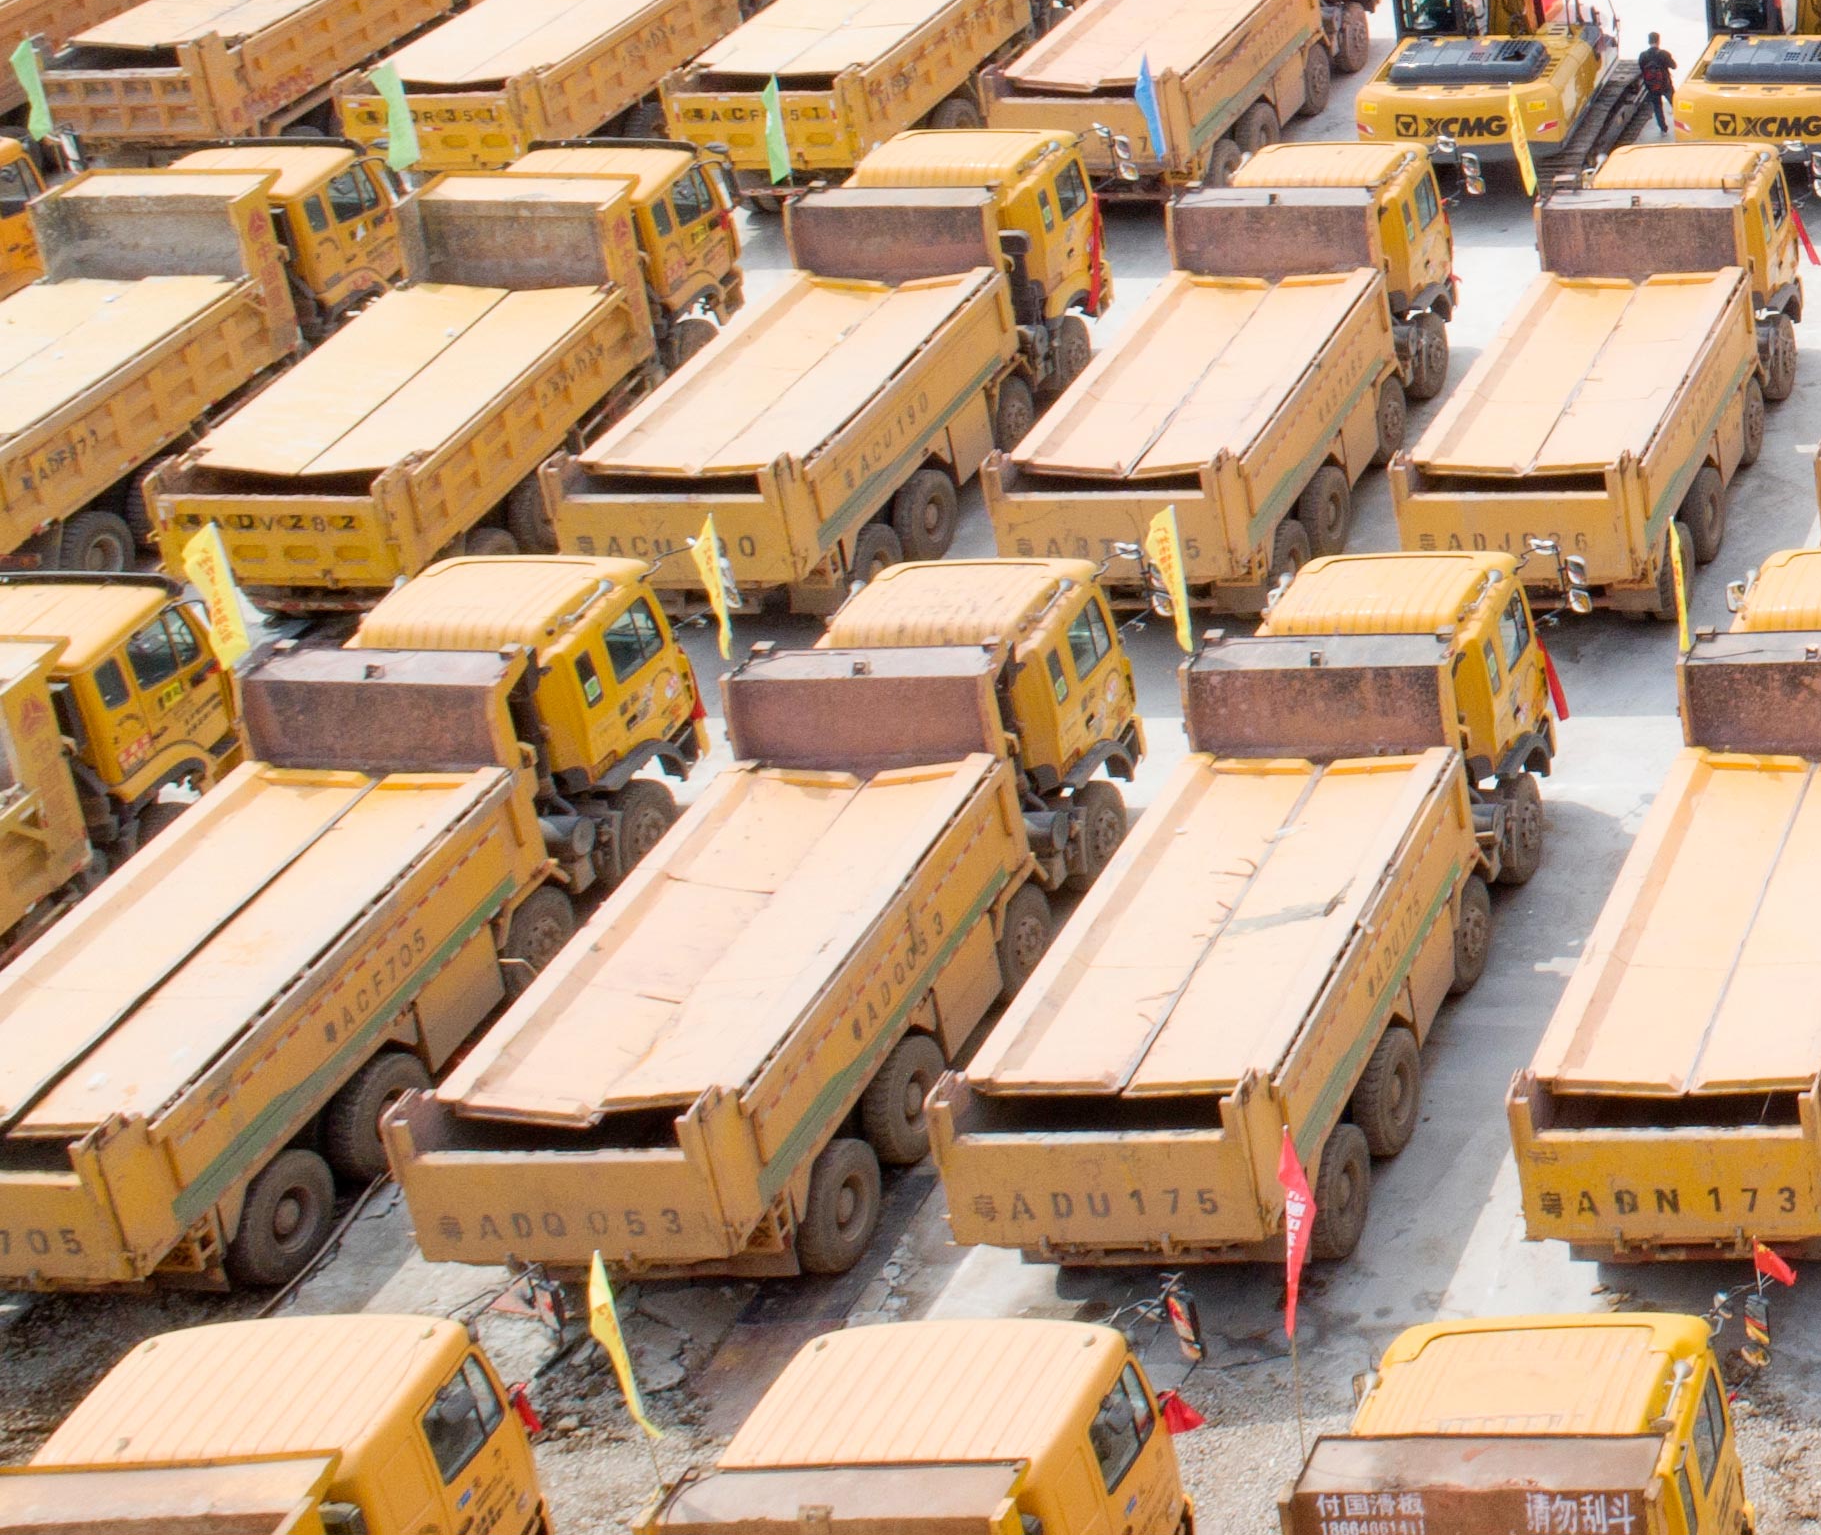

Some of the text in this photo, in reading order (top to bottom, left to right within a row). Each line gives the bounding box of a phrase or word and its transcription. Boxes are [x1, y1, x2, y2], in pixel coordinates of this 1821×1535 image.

[691, 107, 823, 123] ACF51
[1422, 115, 1508, 139] XCMG
[578, 535, 758, 558] 粤ACU90
[1016, 536, 1200, 560] 粤ABT5
[973, 1188, 1221, 1222] 粤ADU175
[1540, 1186, 1798, 1219] 粤ADN173
[1317, 1493, 1425, 1517] 付国滑板
[1525, 1491, 1636, 1533] 请勿刮斗
